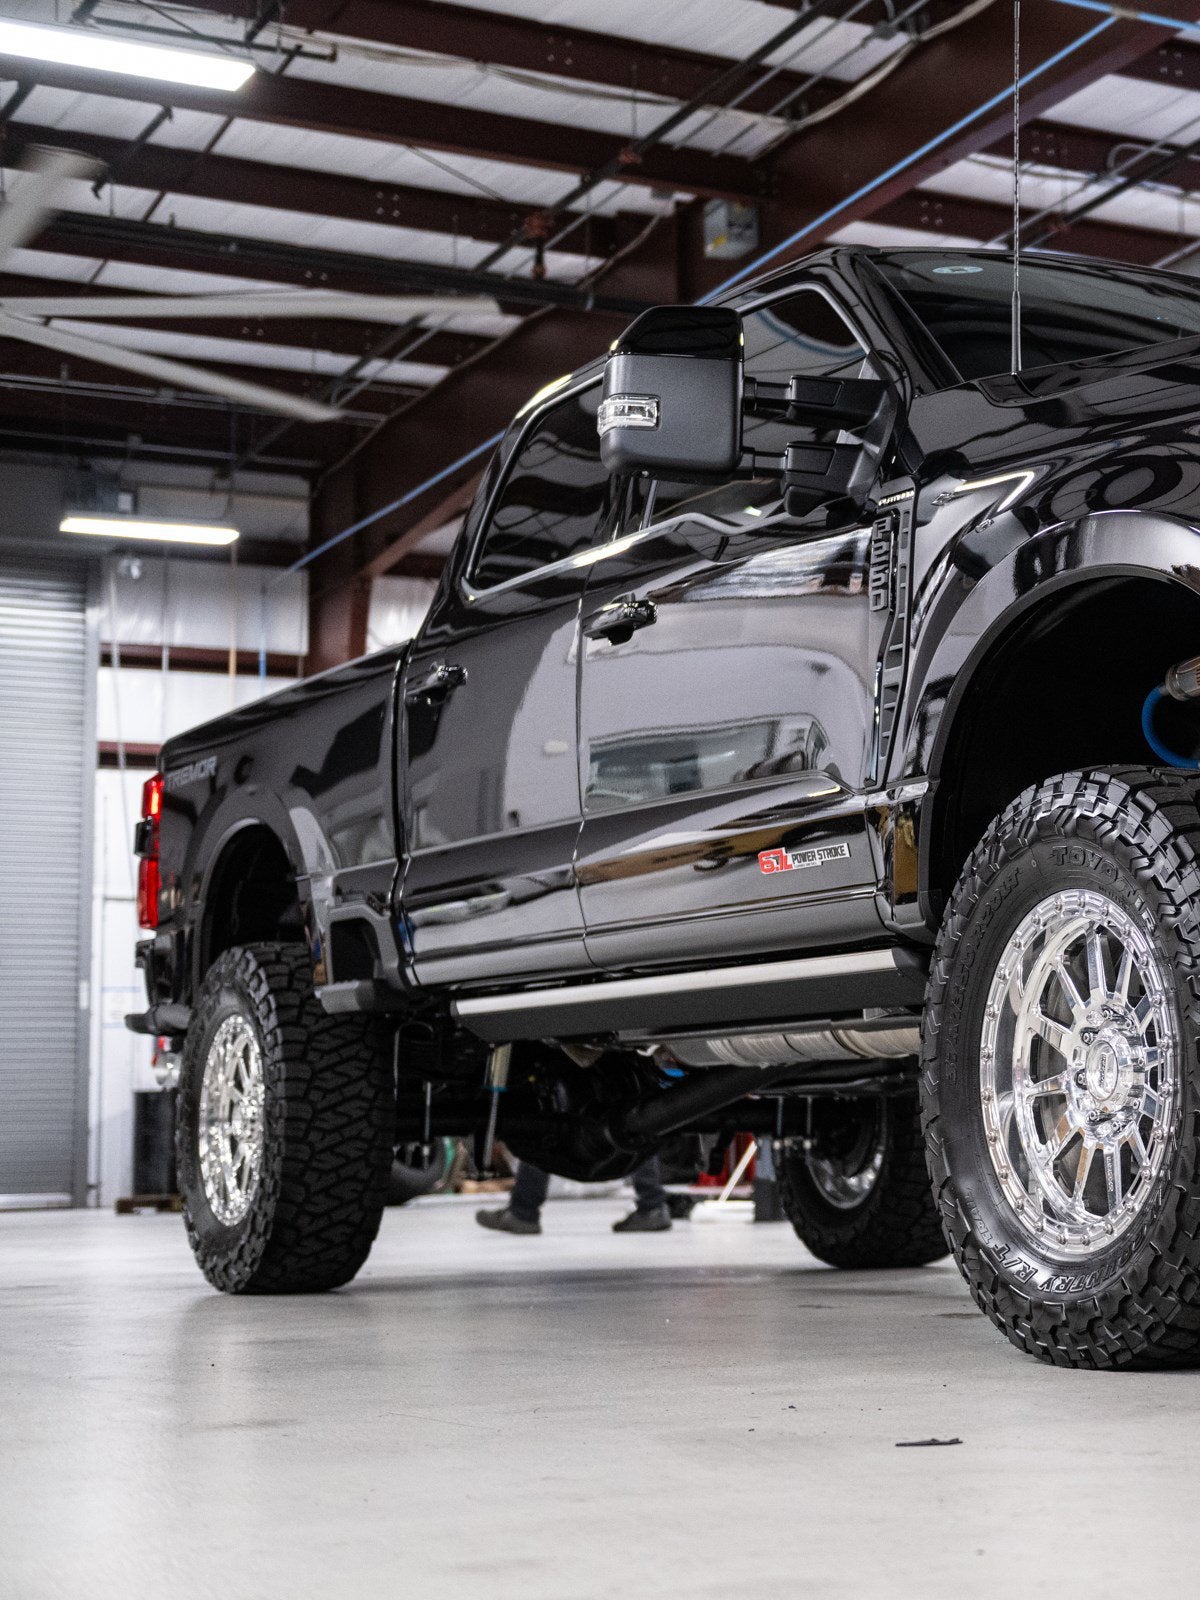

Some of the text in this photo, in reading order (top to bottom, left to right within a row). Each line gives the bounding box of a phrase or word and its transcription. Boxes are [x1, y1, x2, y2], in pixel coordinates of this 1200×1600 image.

[166, 756, 217, 787] TREMOR
[758, 848, 793, 874] 6.7L
[792, 850, 817, 865] POWER
[816, 845, 846, 860] STROKE
[1051, 845, 1119, 885] TOYO
[991, 1243, 1039, 1284] R/T
